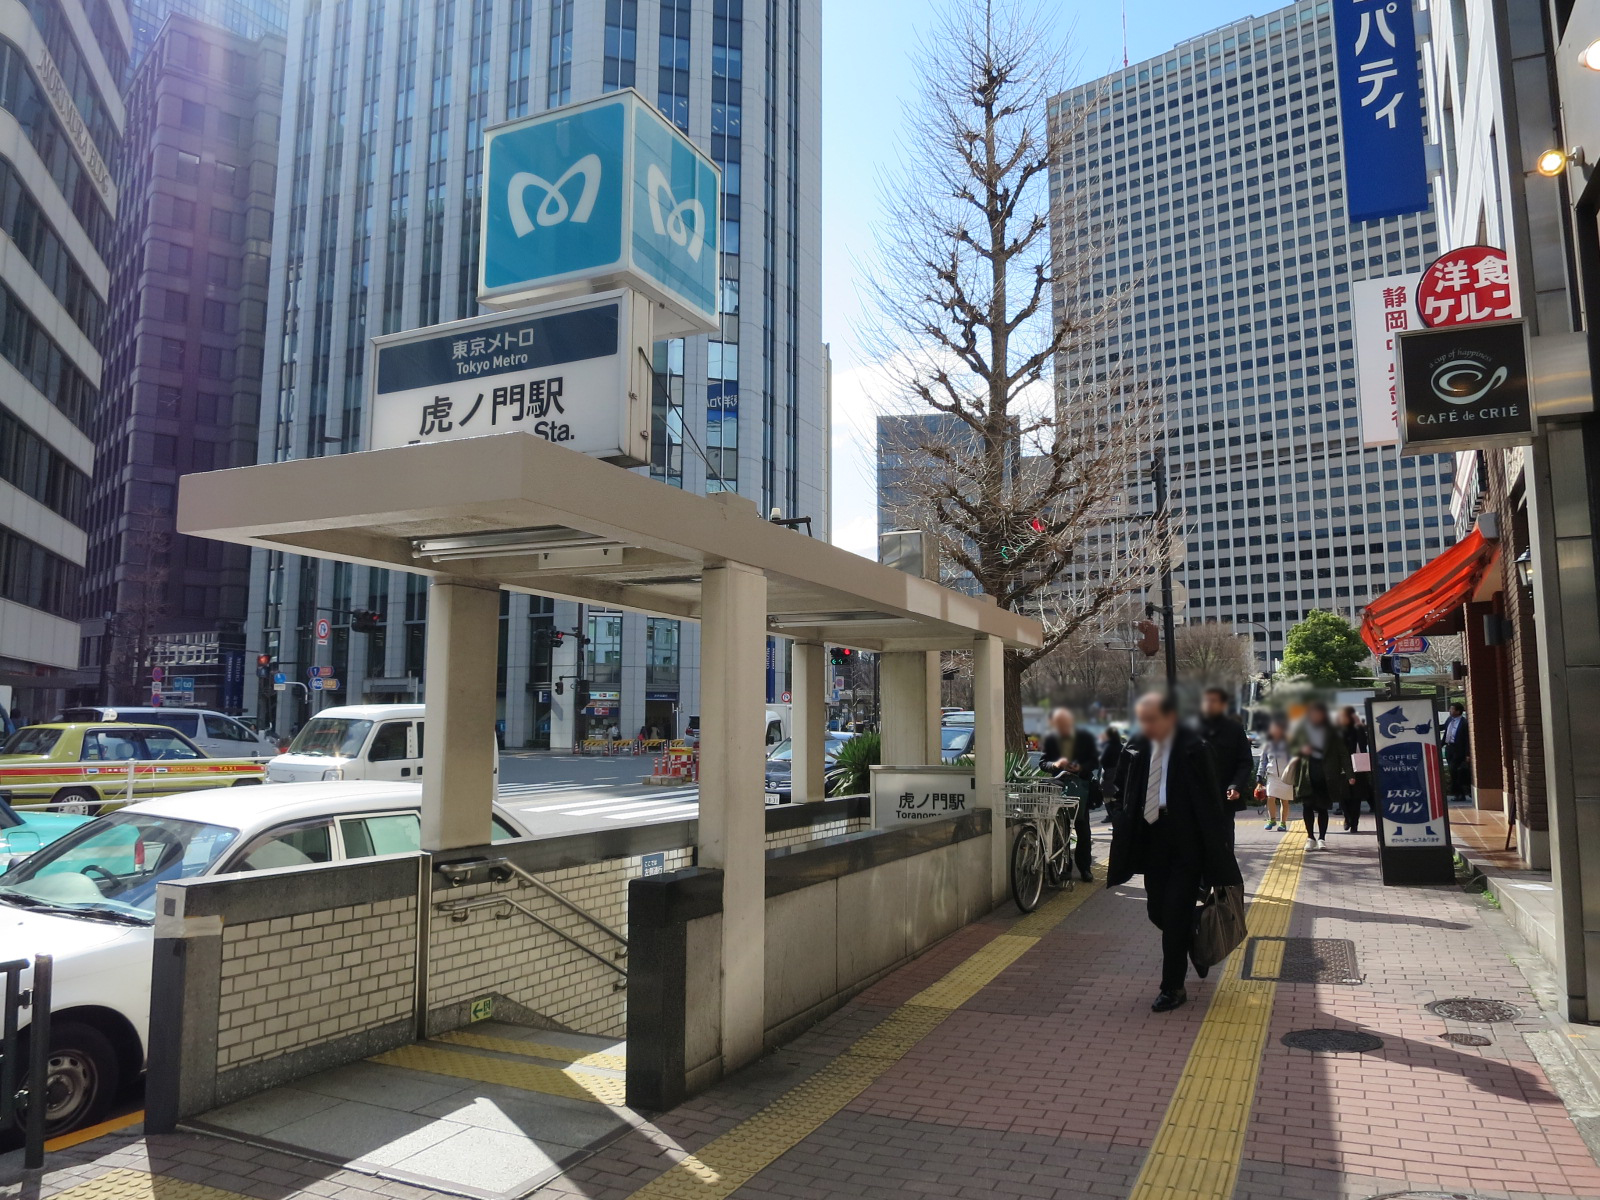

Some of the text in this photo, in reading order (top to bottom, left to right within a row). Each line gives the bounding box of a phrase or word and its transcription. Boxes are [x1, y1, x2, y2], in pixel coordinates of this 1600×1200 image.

[1353, 0, 1404, 129] パティ
[1434, 255, 1509, 293] 洋食
[452, 328, 534, 360] 東京メトロ
[1448, 349, 1456, 361] of
[1457, 347, 1492, 362] happiness
[456, 352, 528, 375] Tokyo Metro
[419, 376, 565, 436] 虎ノ門駅
[1416, 404, 1519, 425] CAFÉ de CRIÉ
[534, 420, 575, 442] Sta.
[899, 792, 965, 810] 虎ノ門駅
[1388, 802, 1423, 814] ケルン
